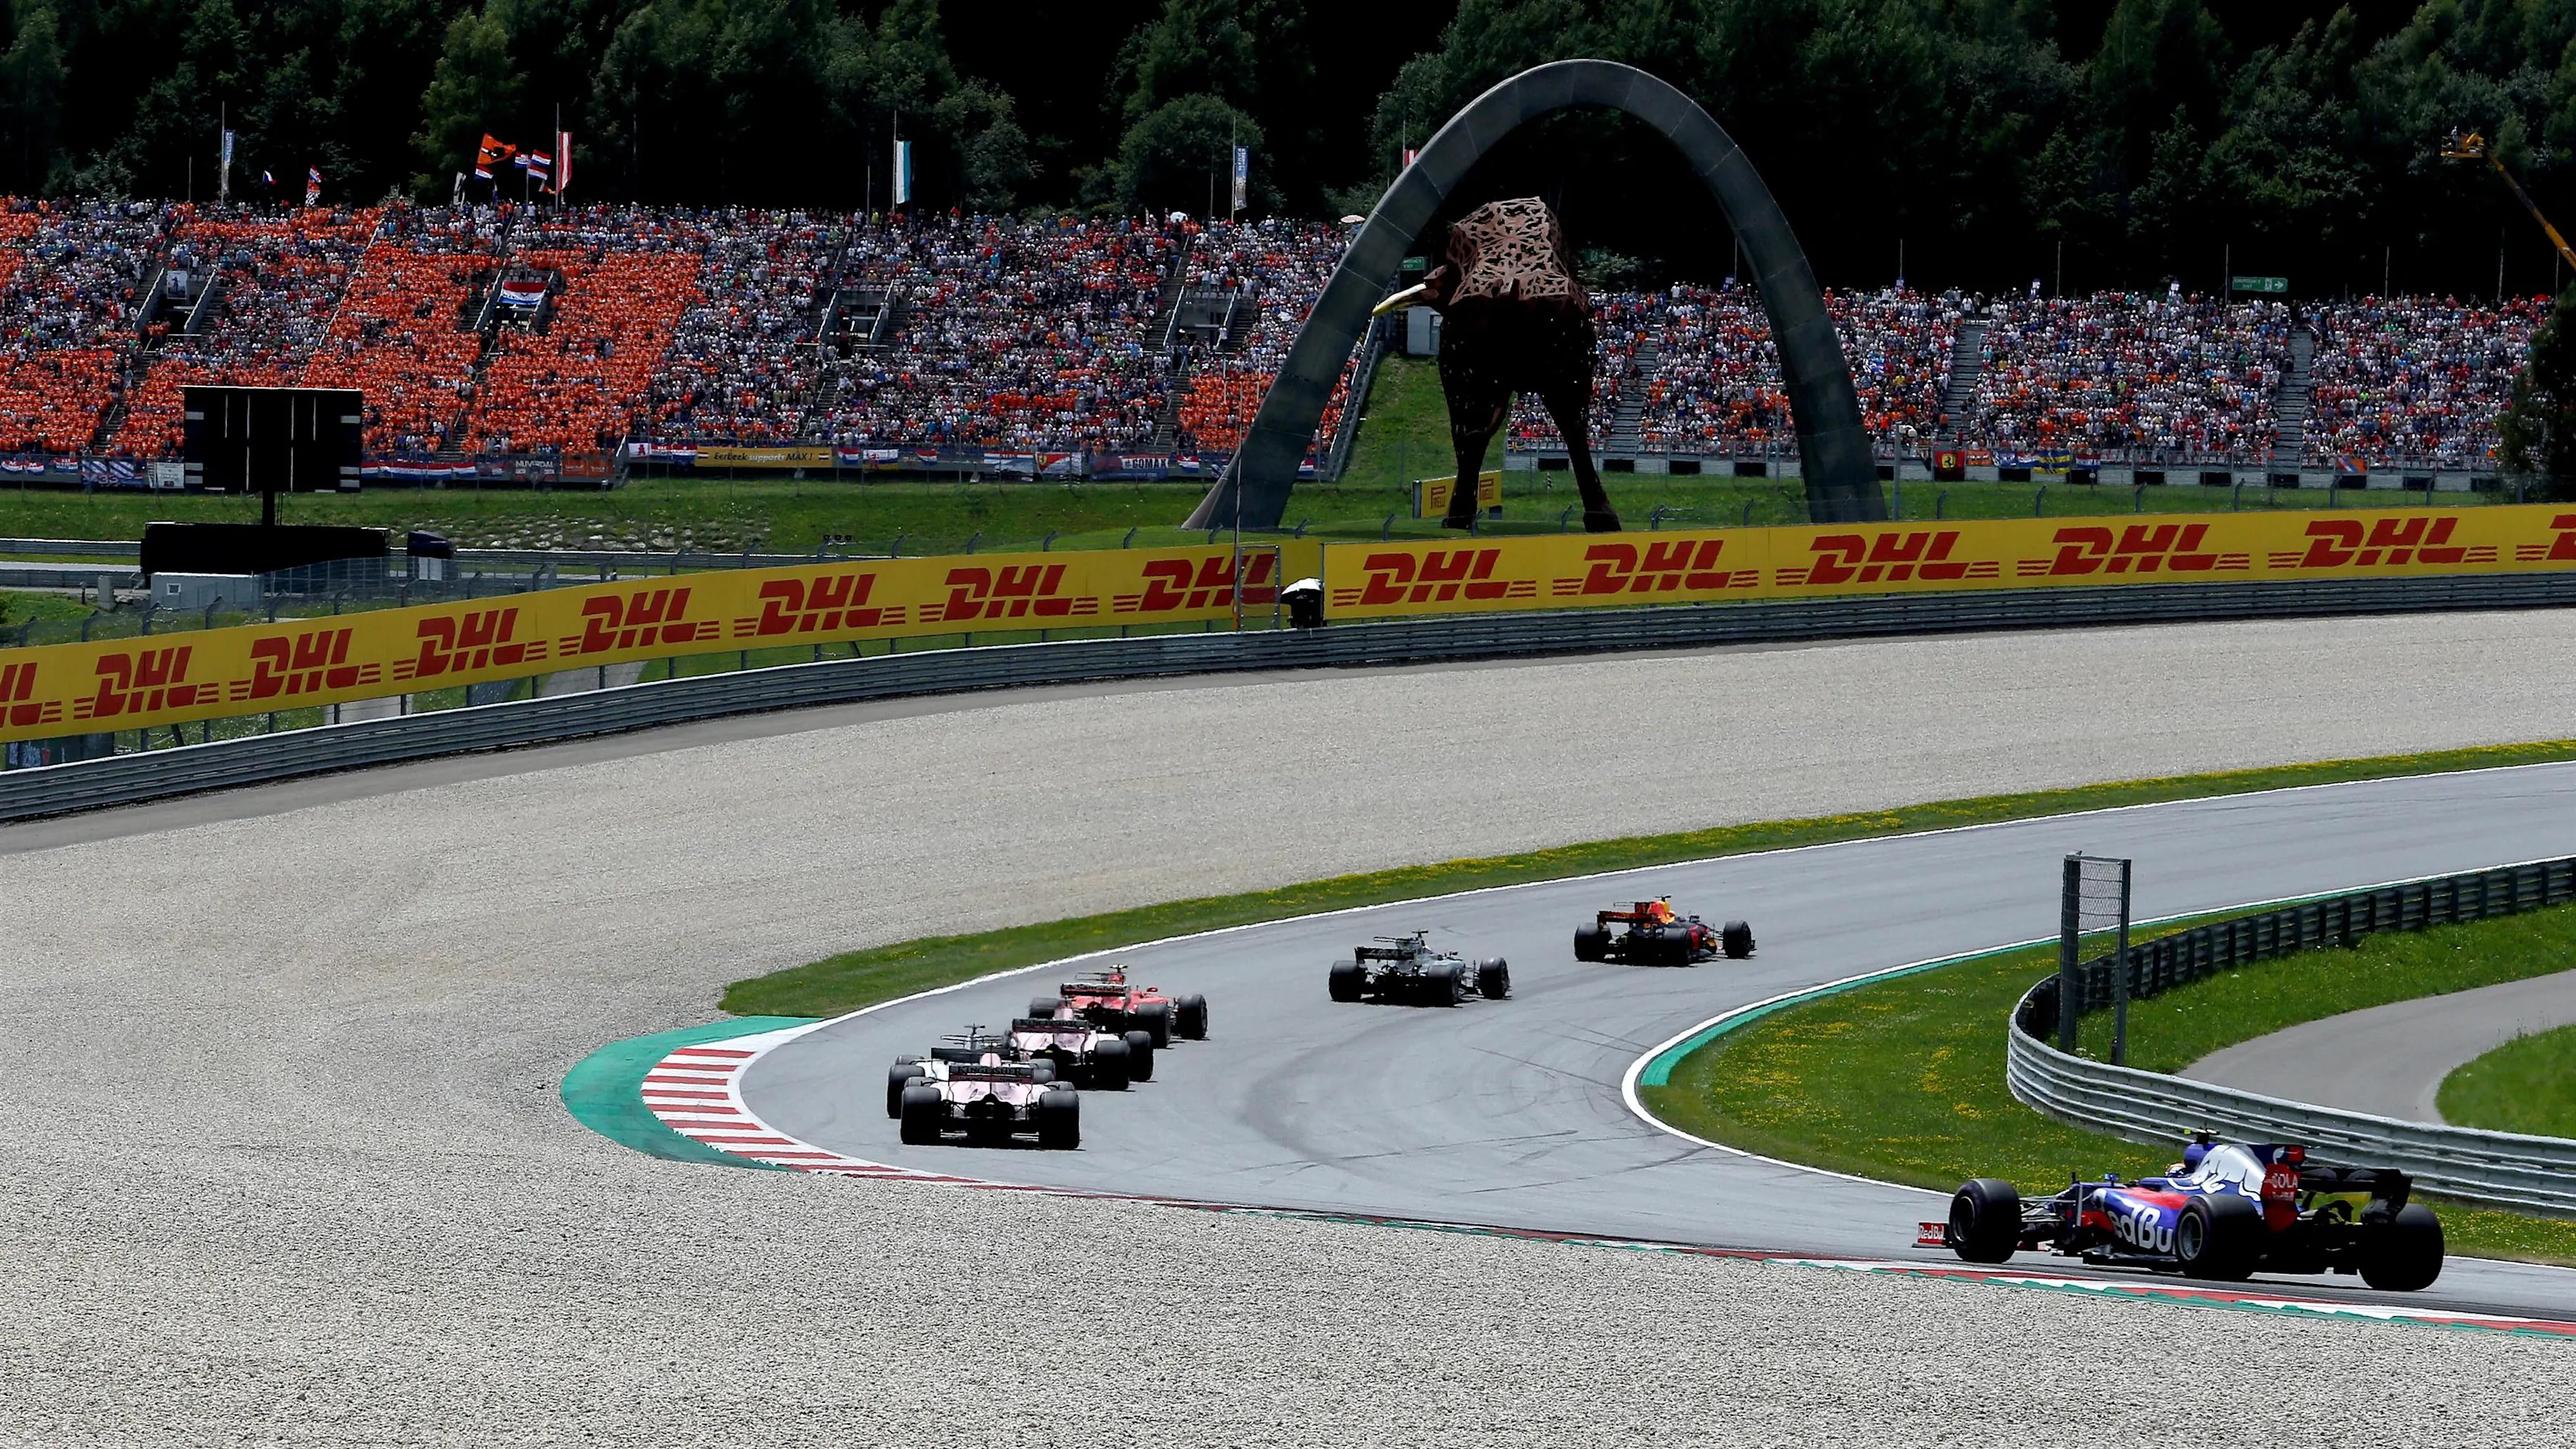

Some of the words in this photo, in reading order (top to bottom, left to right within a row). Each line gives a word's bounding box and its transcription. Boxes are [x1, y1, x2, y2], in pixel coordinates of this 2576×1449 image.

[786, 452, 807, 461] MAX
[1583, 541, 1731, 594] DHL
[1808, 532, 1967, 584] DHL
[2050, 524, 2218, 575] DHL
[2301, 517, 2466, 568] DHL
[757, 574, 883, 635] DHL
[943, 565, 1073, 621] DHL
[1139, 554, 1280, 612] DHL
[1360, 549, 1509, 606] DHL
[415, 608, 526, 677] DHL
[580, 588, 698, 654] DHL
[93, 646, 198, 718] DHL
[250, 629, 361, 699] DHL
